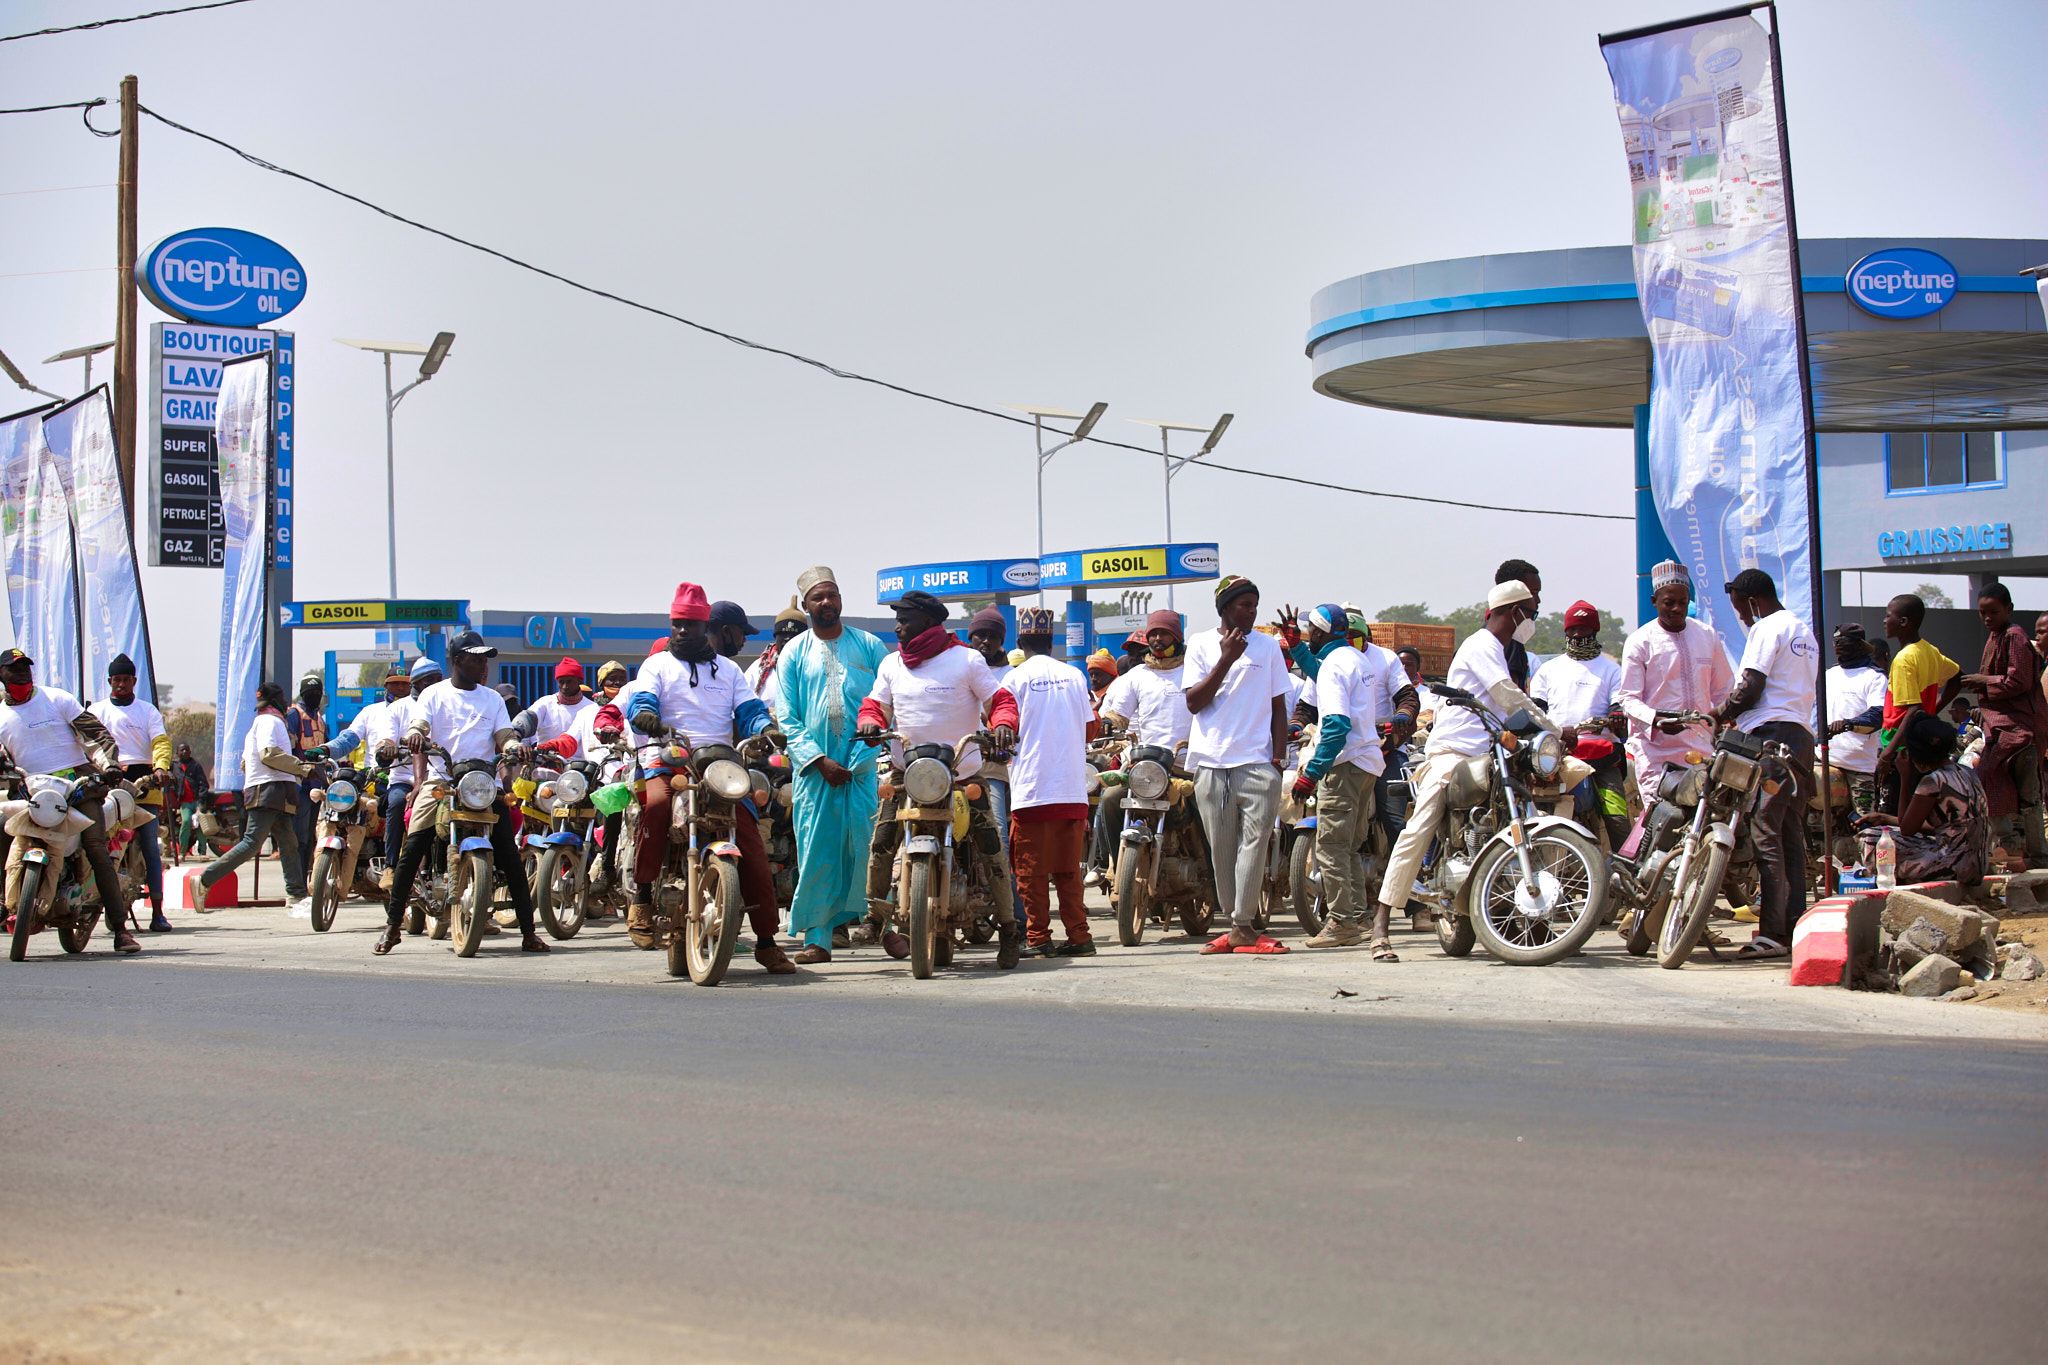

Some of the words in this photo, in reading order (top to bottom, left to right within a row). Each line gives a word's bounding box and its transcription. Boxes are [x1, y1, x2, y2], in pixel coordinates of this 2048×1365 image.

[164, 255, 300, 292] neptune
[1859, 269, 1955, 294] neptune
[257, 295, 282, 314] OIL
[1925, 292, 1943, 304] OIL
[164, 330, 271, 354] BOUTIQUE
[168, 365, 223, 388] LAV
[163, 439, 207, 453] SUPER
[277, 349, 293, 544] neptune
[164, 472, 208, 486] GASOIL
[162, 507, 207, 521] PETROLE
[163, 539, 193, 553] GAZ
[1877, 523, 2010, 559] GRAISSAGE
[277, 554, 291, 563] OIL
[1040, 561, 1068, 579] SUPER
[1091, 556, 1149, 574] GASOIL
[879, 576, 904, 593] SUPER
[922, 570, 969, 588] SUPER
[311, 606, 369, 619] GASOIL
[395, 607, 453, 618] PETROLE
